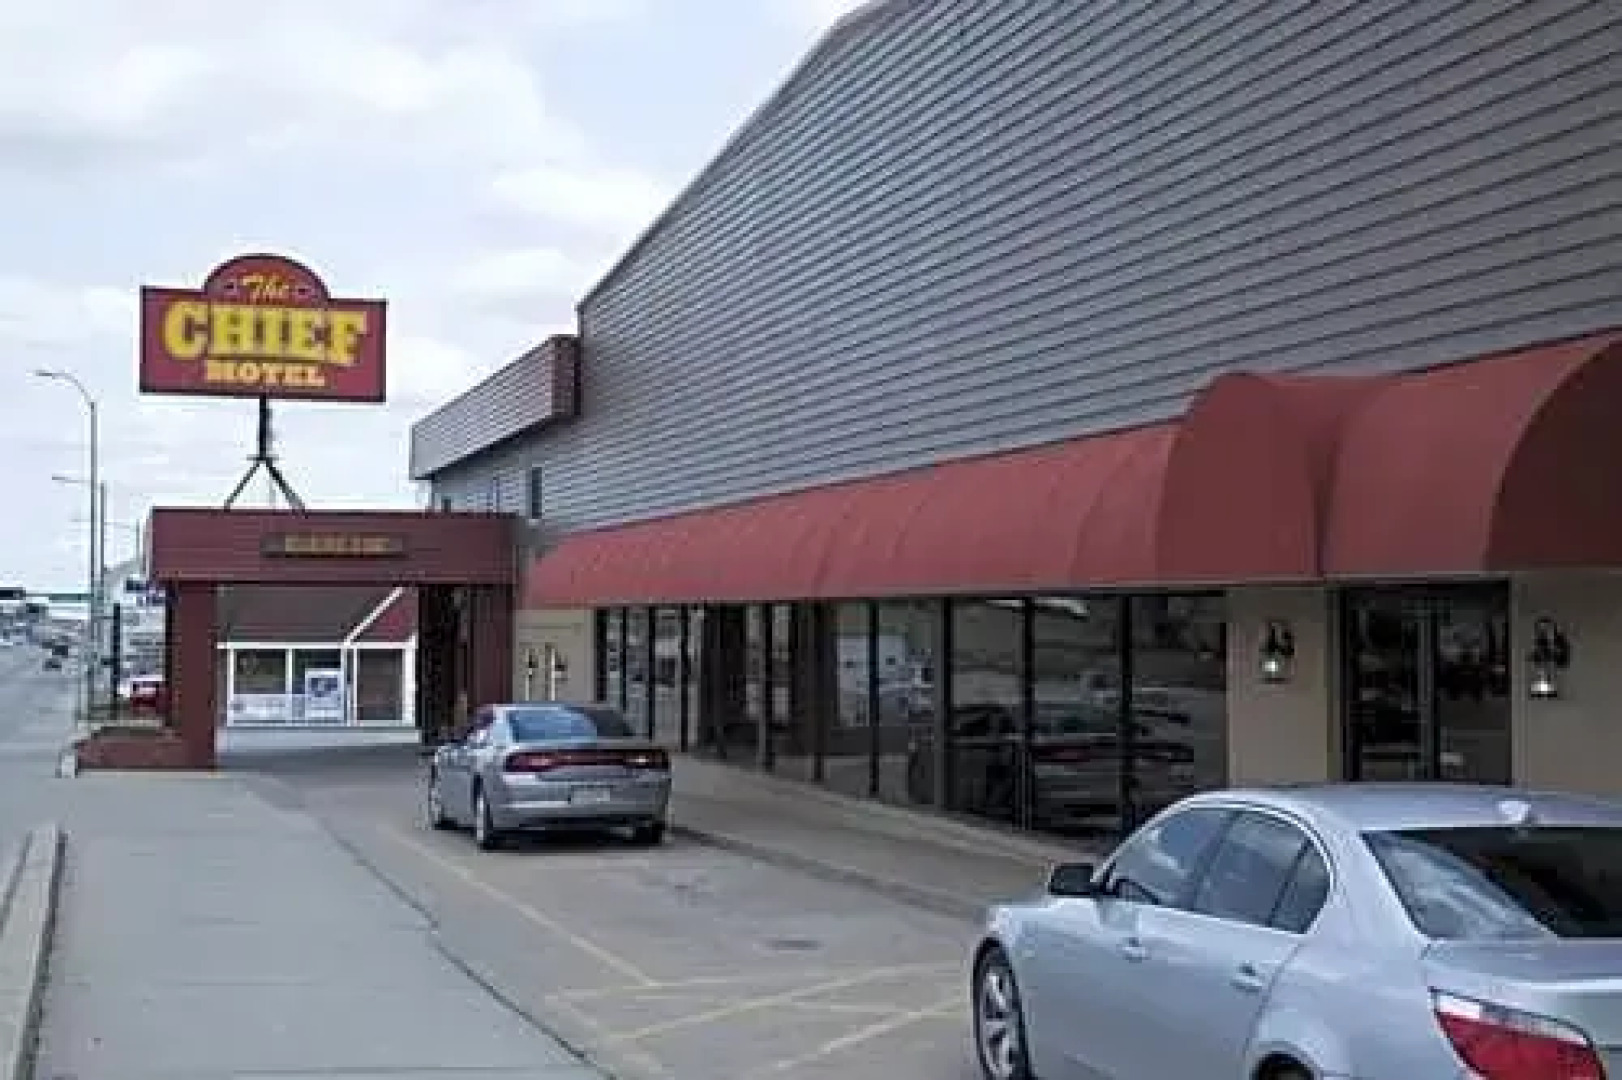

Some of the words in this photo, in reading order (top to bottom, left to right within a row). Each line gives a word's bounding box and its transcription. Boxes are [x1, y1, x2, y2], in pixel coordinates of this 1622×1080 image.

[241, 274, 290, 301] The
[163, 300, 368, 367] CHIEF
[204, 359, 326, 387] MOTEL
